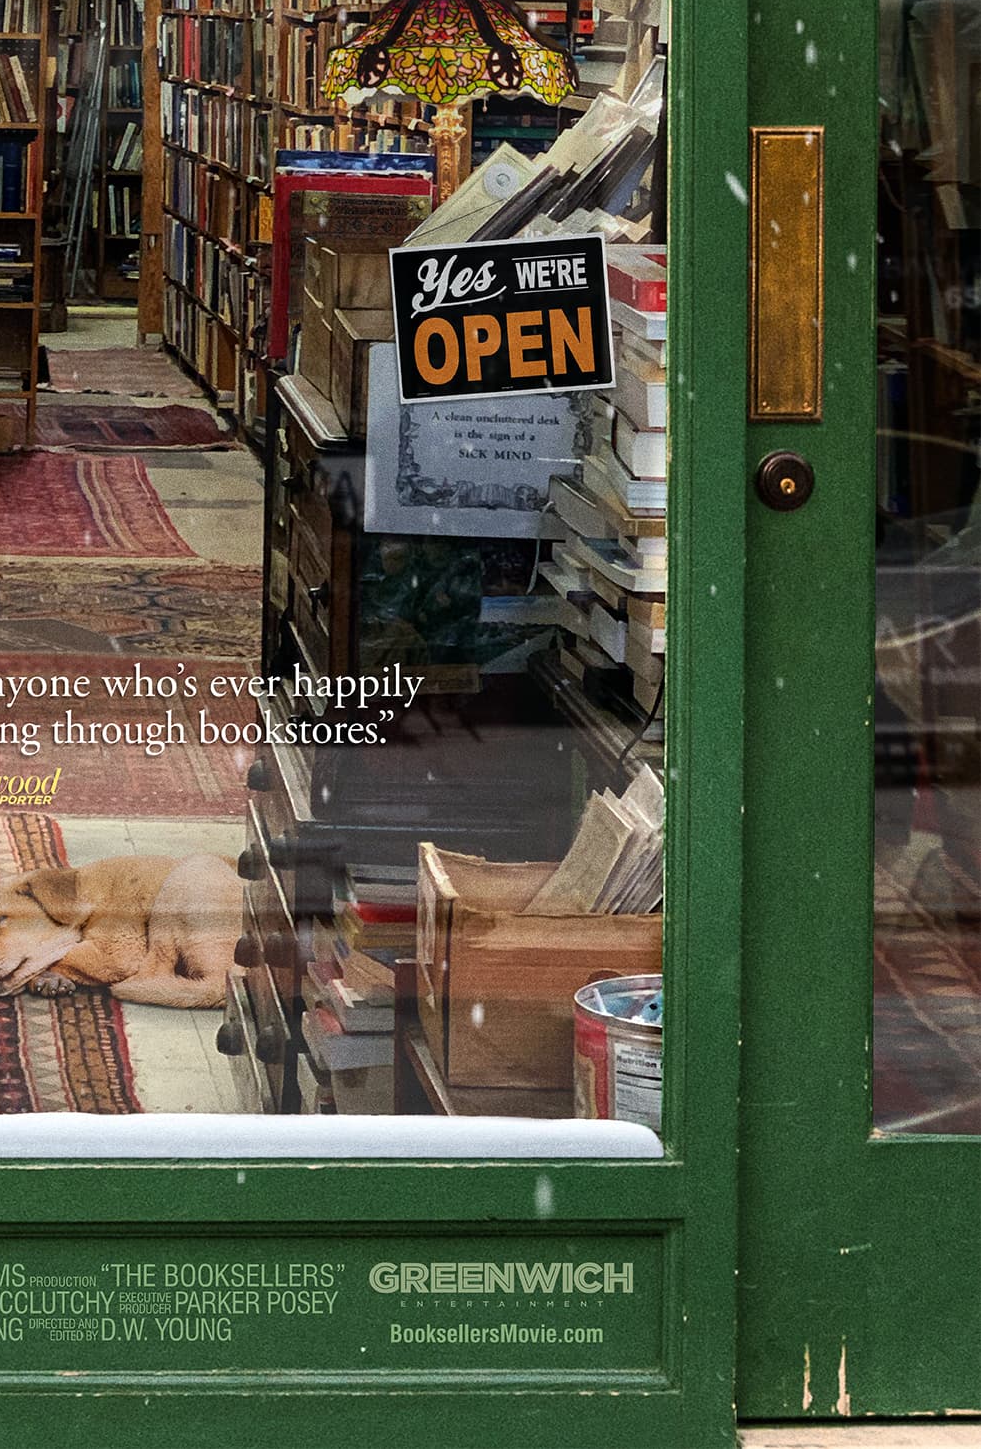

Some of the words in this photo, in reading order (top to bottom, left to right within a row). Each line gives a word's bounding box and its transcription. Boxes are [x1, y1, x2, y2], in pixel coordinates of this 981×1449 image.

[411, 254, 506, 318] Yes
[414, 307, 596, 386] OPEN
[445, 412, 472, 422] clean
[537, 415, 560, 425] desk
[494, 450, 532, 460] MIND
